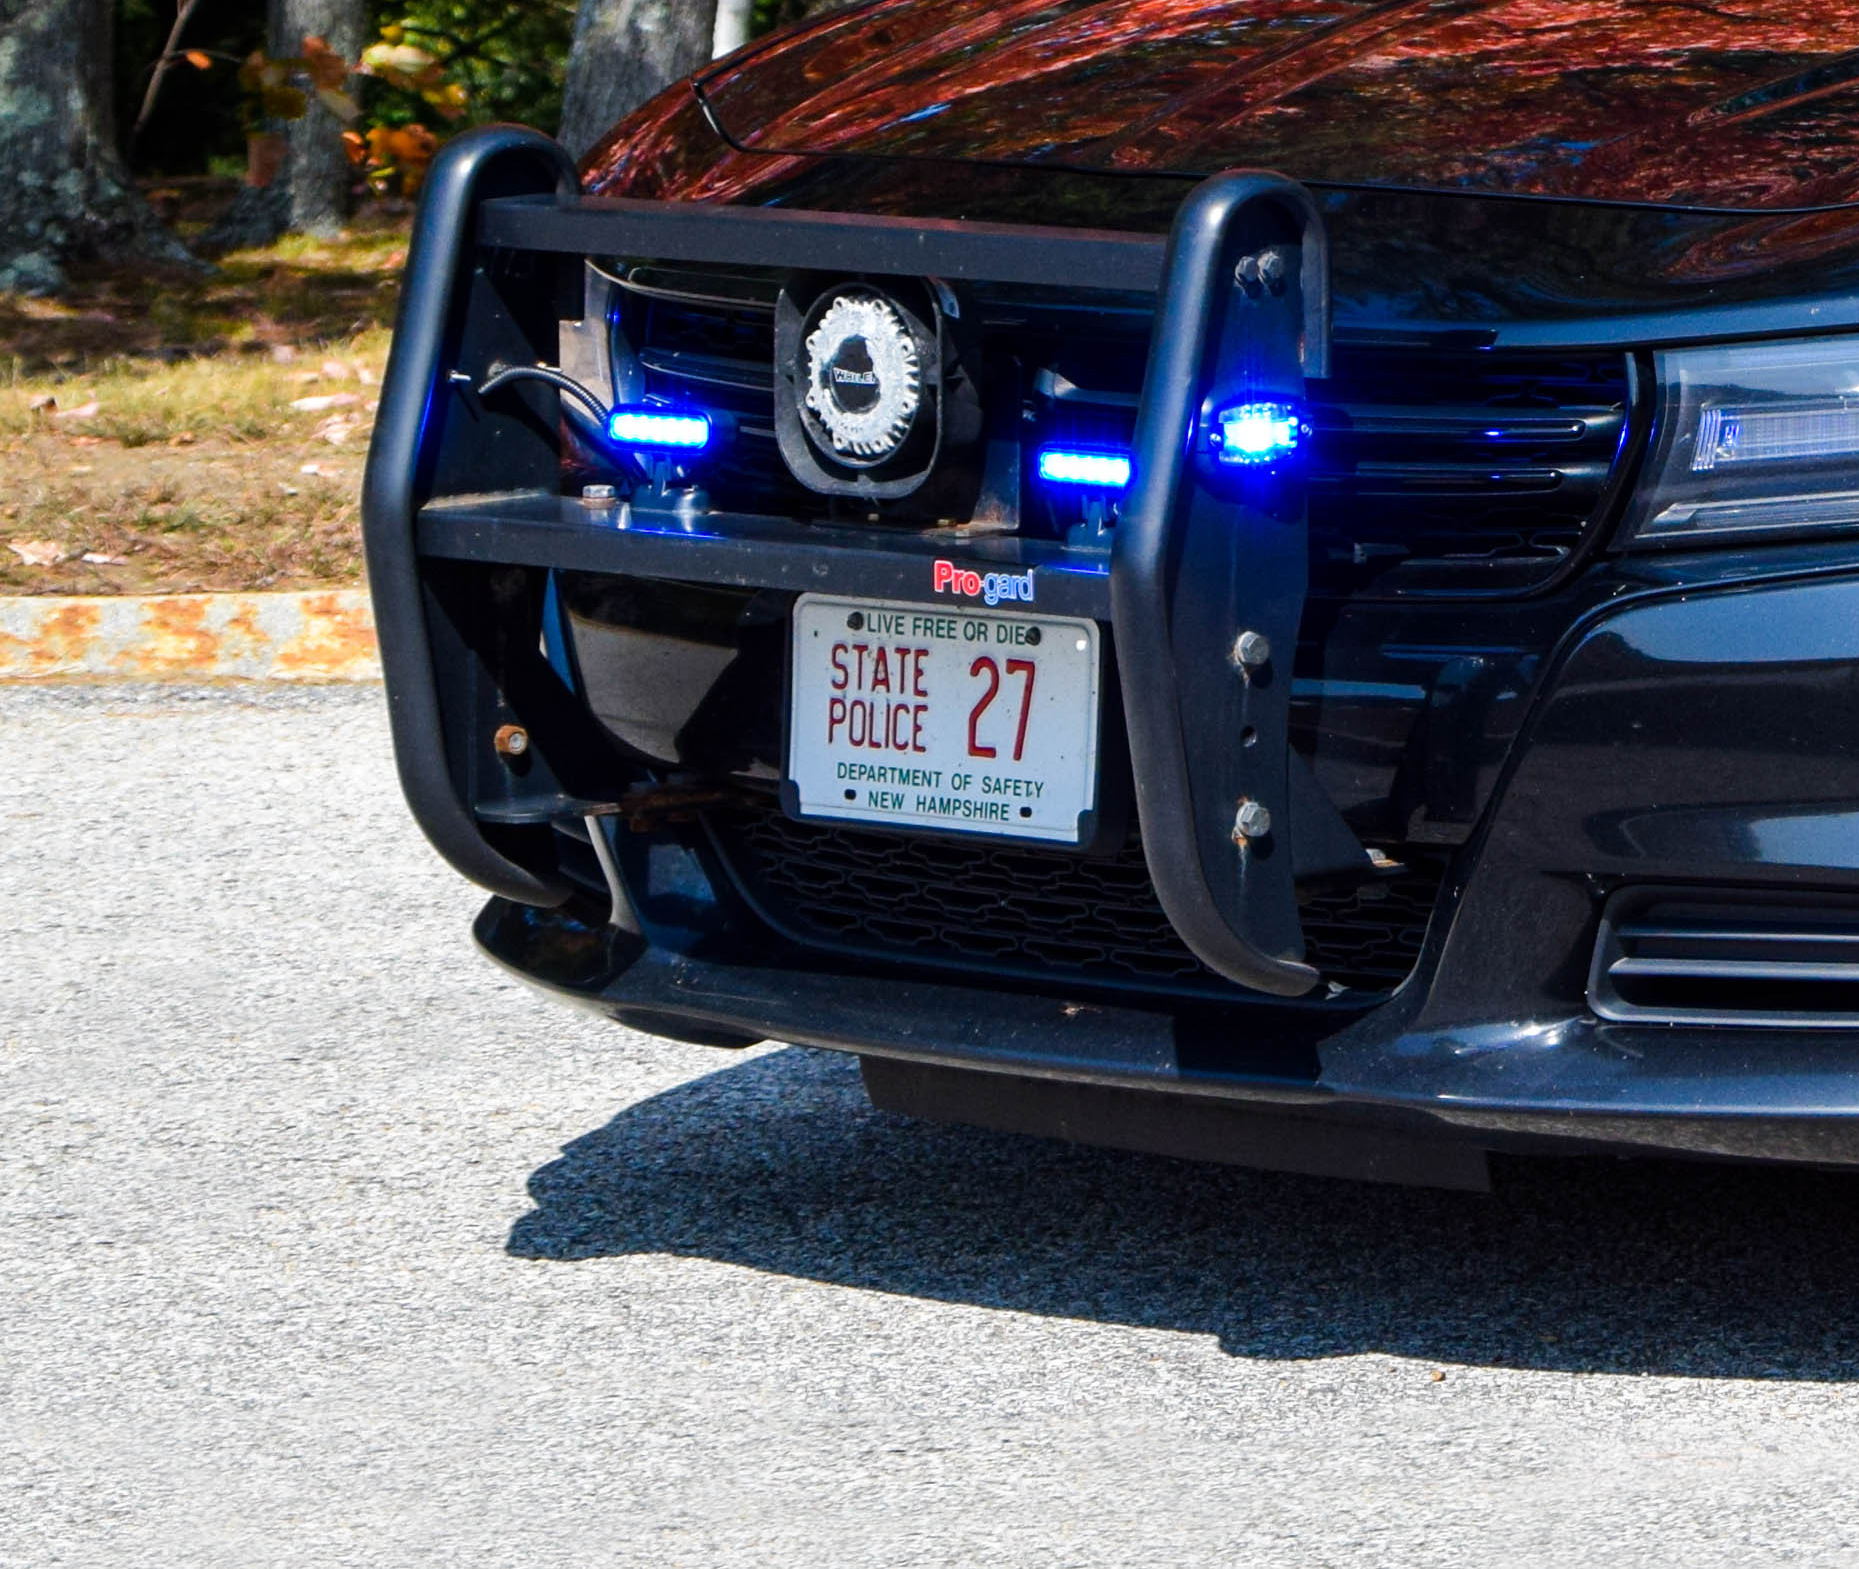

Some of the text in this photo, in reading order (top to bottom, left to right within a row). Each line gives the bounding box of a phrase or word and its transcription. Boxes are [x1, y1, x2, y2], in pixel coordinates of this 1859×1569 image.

[866, 613, 1026, 645] LIVE FREE OR DIE
[831, 643, 930, 698] STATE
[828, 698, 929, 753] POLICE
[967, 655, 1037, 762] 27
[836, 762, 1045, 798] DEPARTMENT OF SAFETY
[867, 791, 1010, 821] NEW HAMPSHIRE
